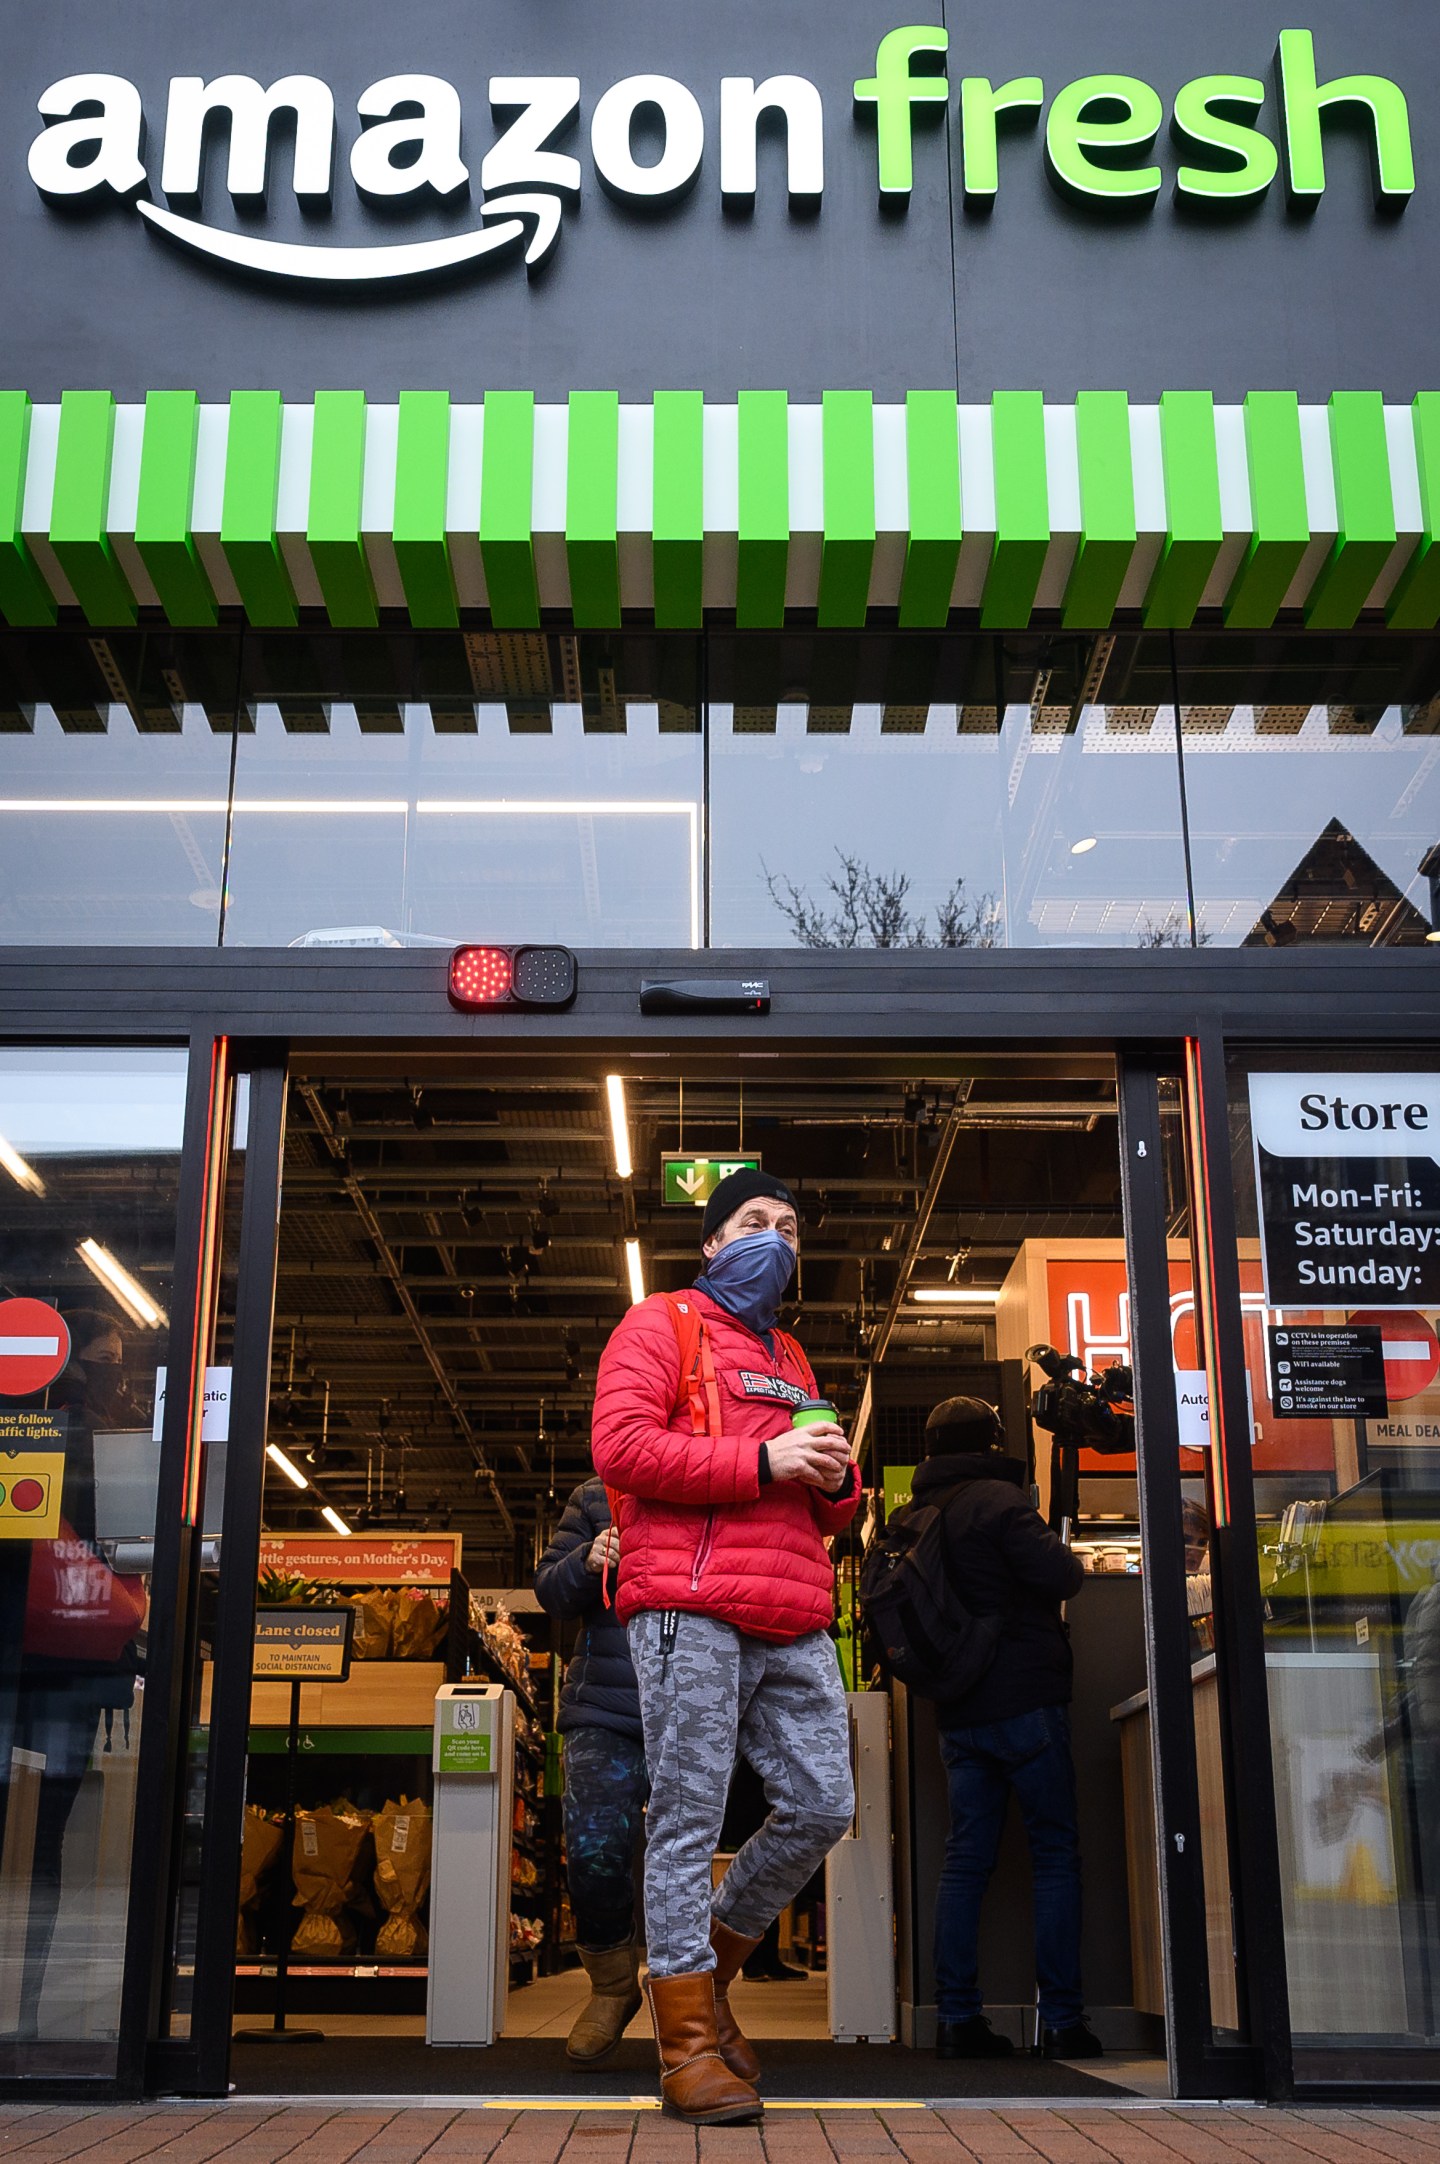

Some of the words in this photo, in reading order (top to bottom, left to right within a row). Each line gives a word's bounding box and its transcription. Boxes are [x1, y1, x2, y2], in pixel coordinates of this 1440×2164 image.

[26, 73, 825, 197] amazon
[854, 25, 1415, 197] fresh
[1300, 1094, 1428, 1131] Store
[1292, 1183, 1422, 1208] Mon-Fri:
[1294, 1221, 1440, 1252] Saturday:
[1297, 1259, 1422, 1291] Sunday:
[18, 1413, 54, 1424] follow
[26, 1426, 62, 1440] lights.
[1376, 1424, 1412, 1437] MEAL
[285, 1554, 342, 1567] gestures,
[344, 1555, 360, 1564] on
[362, 1553, 419, 1564] Mother's
[421, 1553, 448, 1567] Day.
[256, 1624, 291, 1636] Lane
[294, 1624, 340, 1637] closed
[281, 1654, 321, 1662] MAINTAIN
[255, 1662, 283, 1670] SOCIAL
[285, 1663, 332, 1671] DISTANCING
